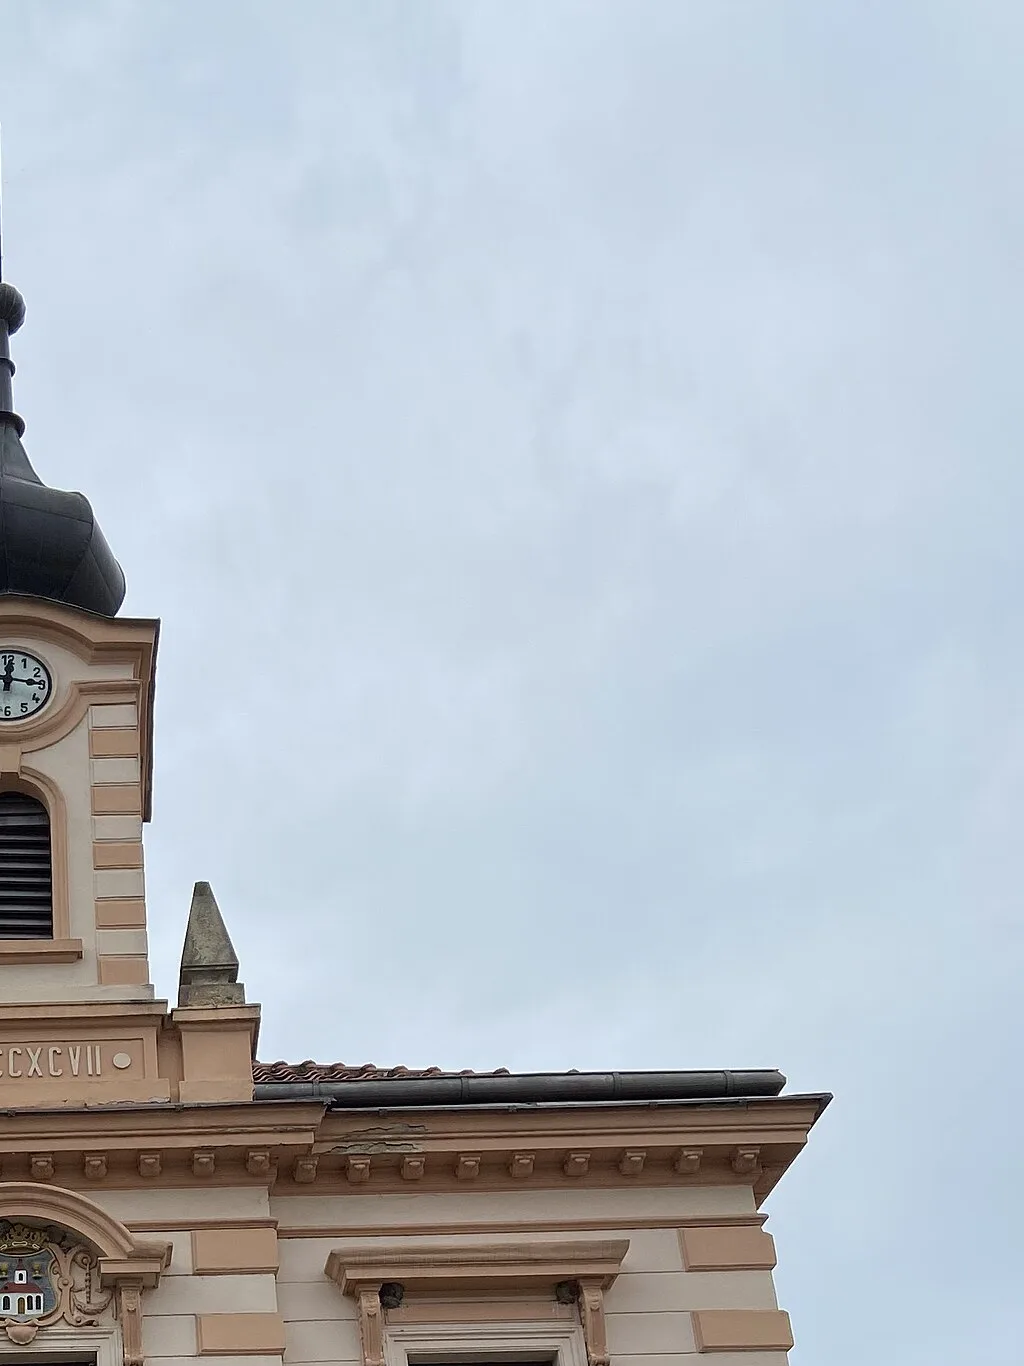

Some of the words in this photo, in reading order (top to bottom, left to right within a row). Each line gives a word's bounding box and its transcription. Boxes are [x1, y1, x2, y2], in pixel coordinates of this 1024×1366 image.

[21, 658, 27, 669] 1
[33, 667, 41, 677] 2
[38, 679, 46, 690] 3
[32, 693, 40, 703] 4
[4, 706, 11, 716] 6
[21, 703, 28, 713] 5
